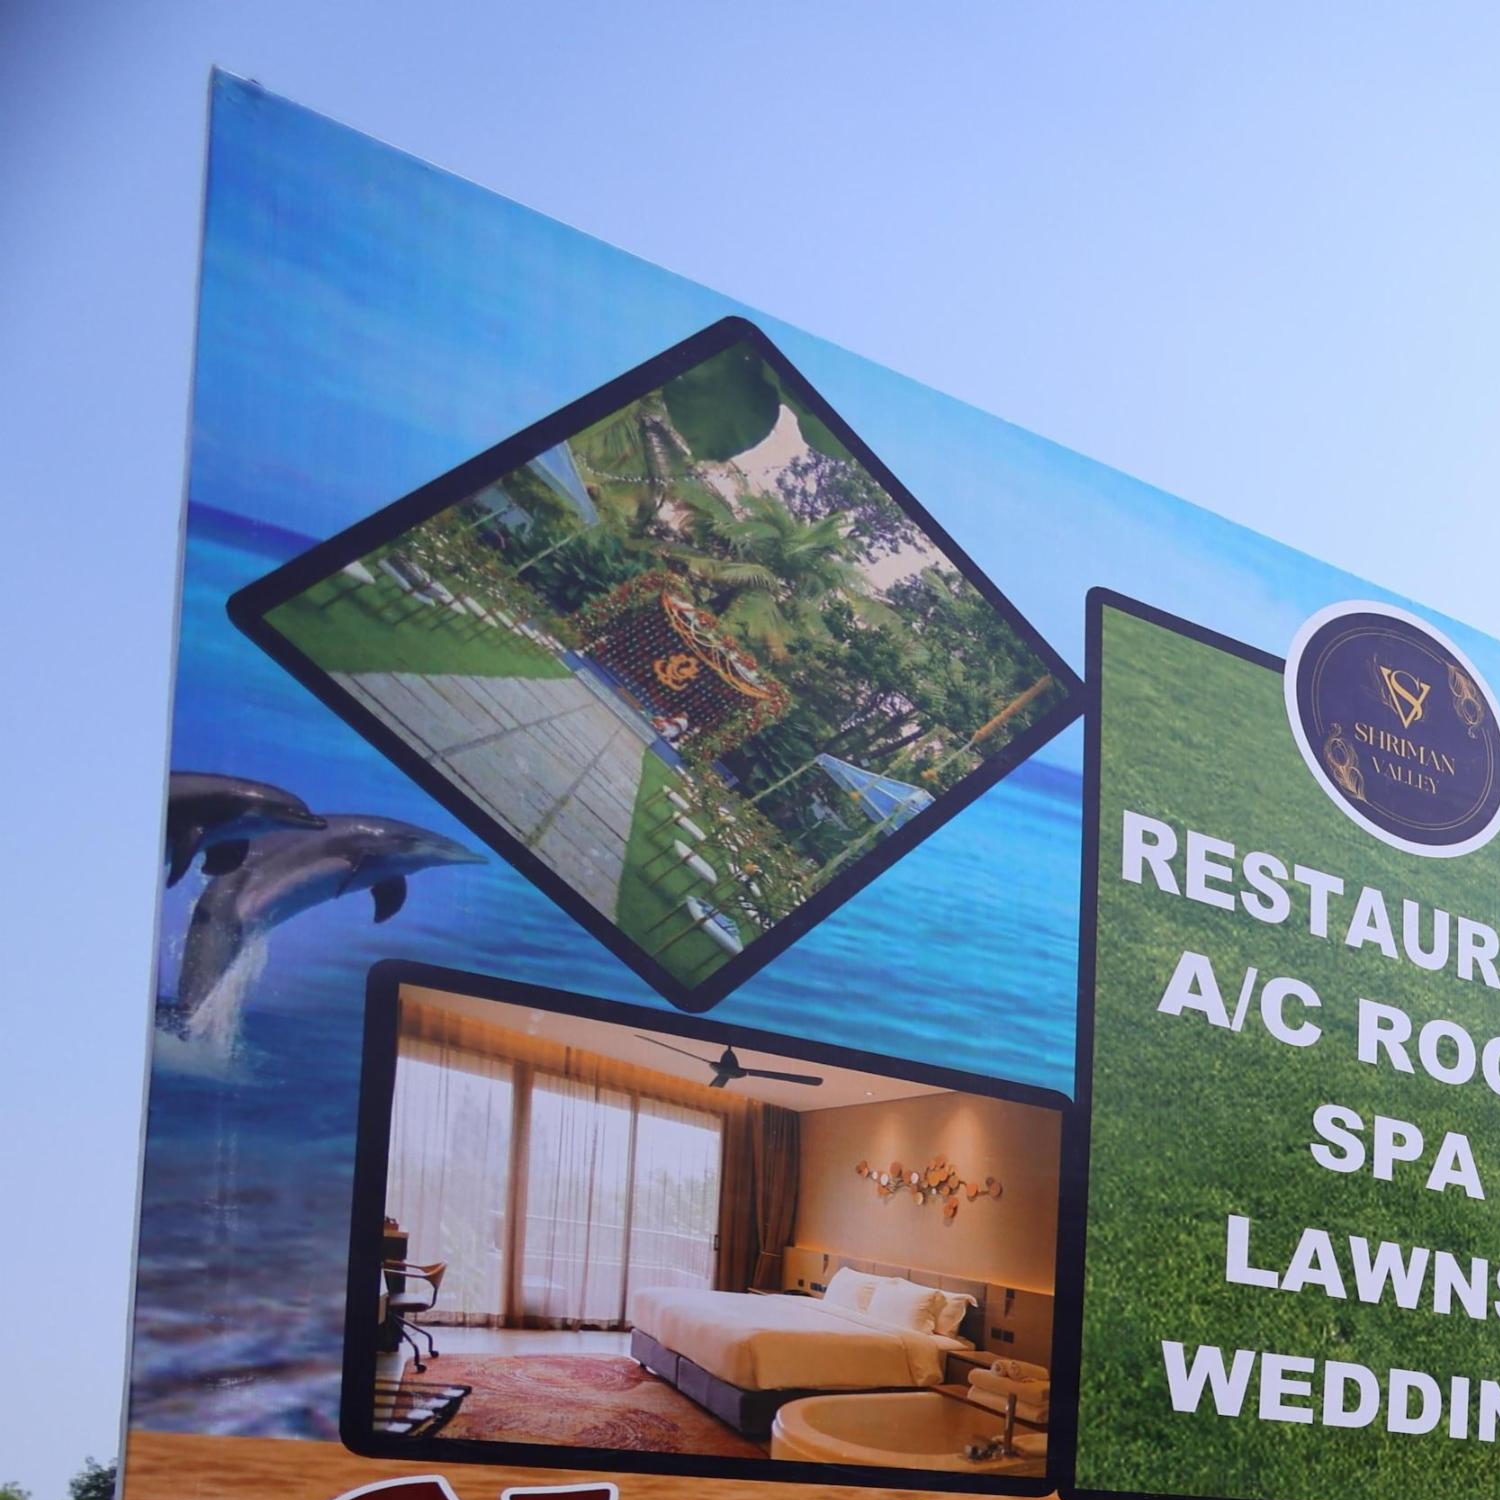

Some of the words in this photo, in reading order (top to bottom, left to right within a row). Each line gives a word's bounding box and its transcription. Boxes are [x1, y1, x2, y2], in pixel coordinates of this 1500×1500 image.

[1355, 722, 1456, 776] SHRIMAN
[1372, 756, 1438, 795] VALLEY
[1158, 950, 1322, 1047] A/C
[1310, 1104, 1486, 1201] SPA
